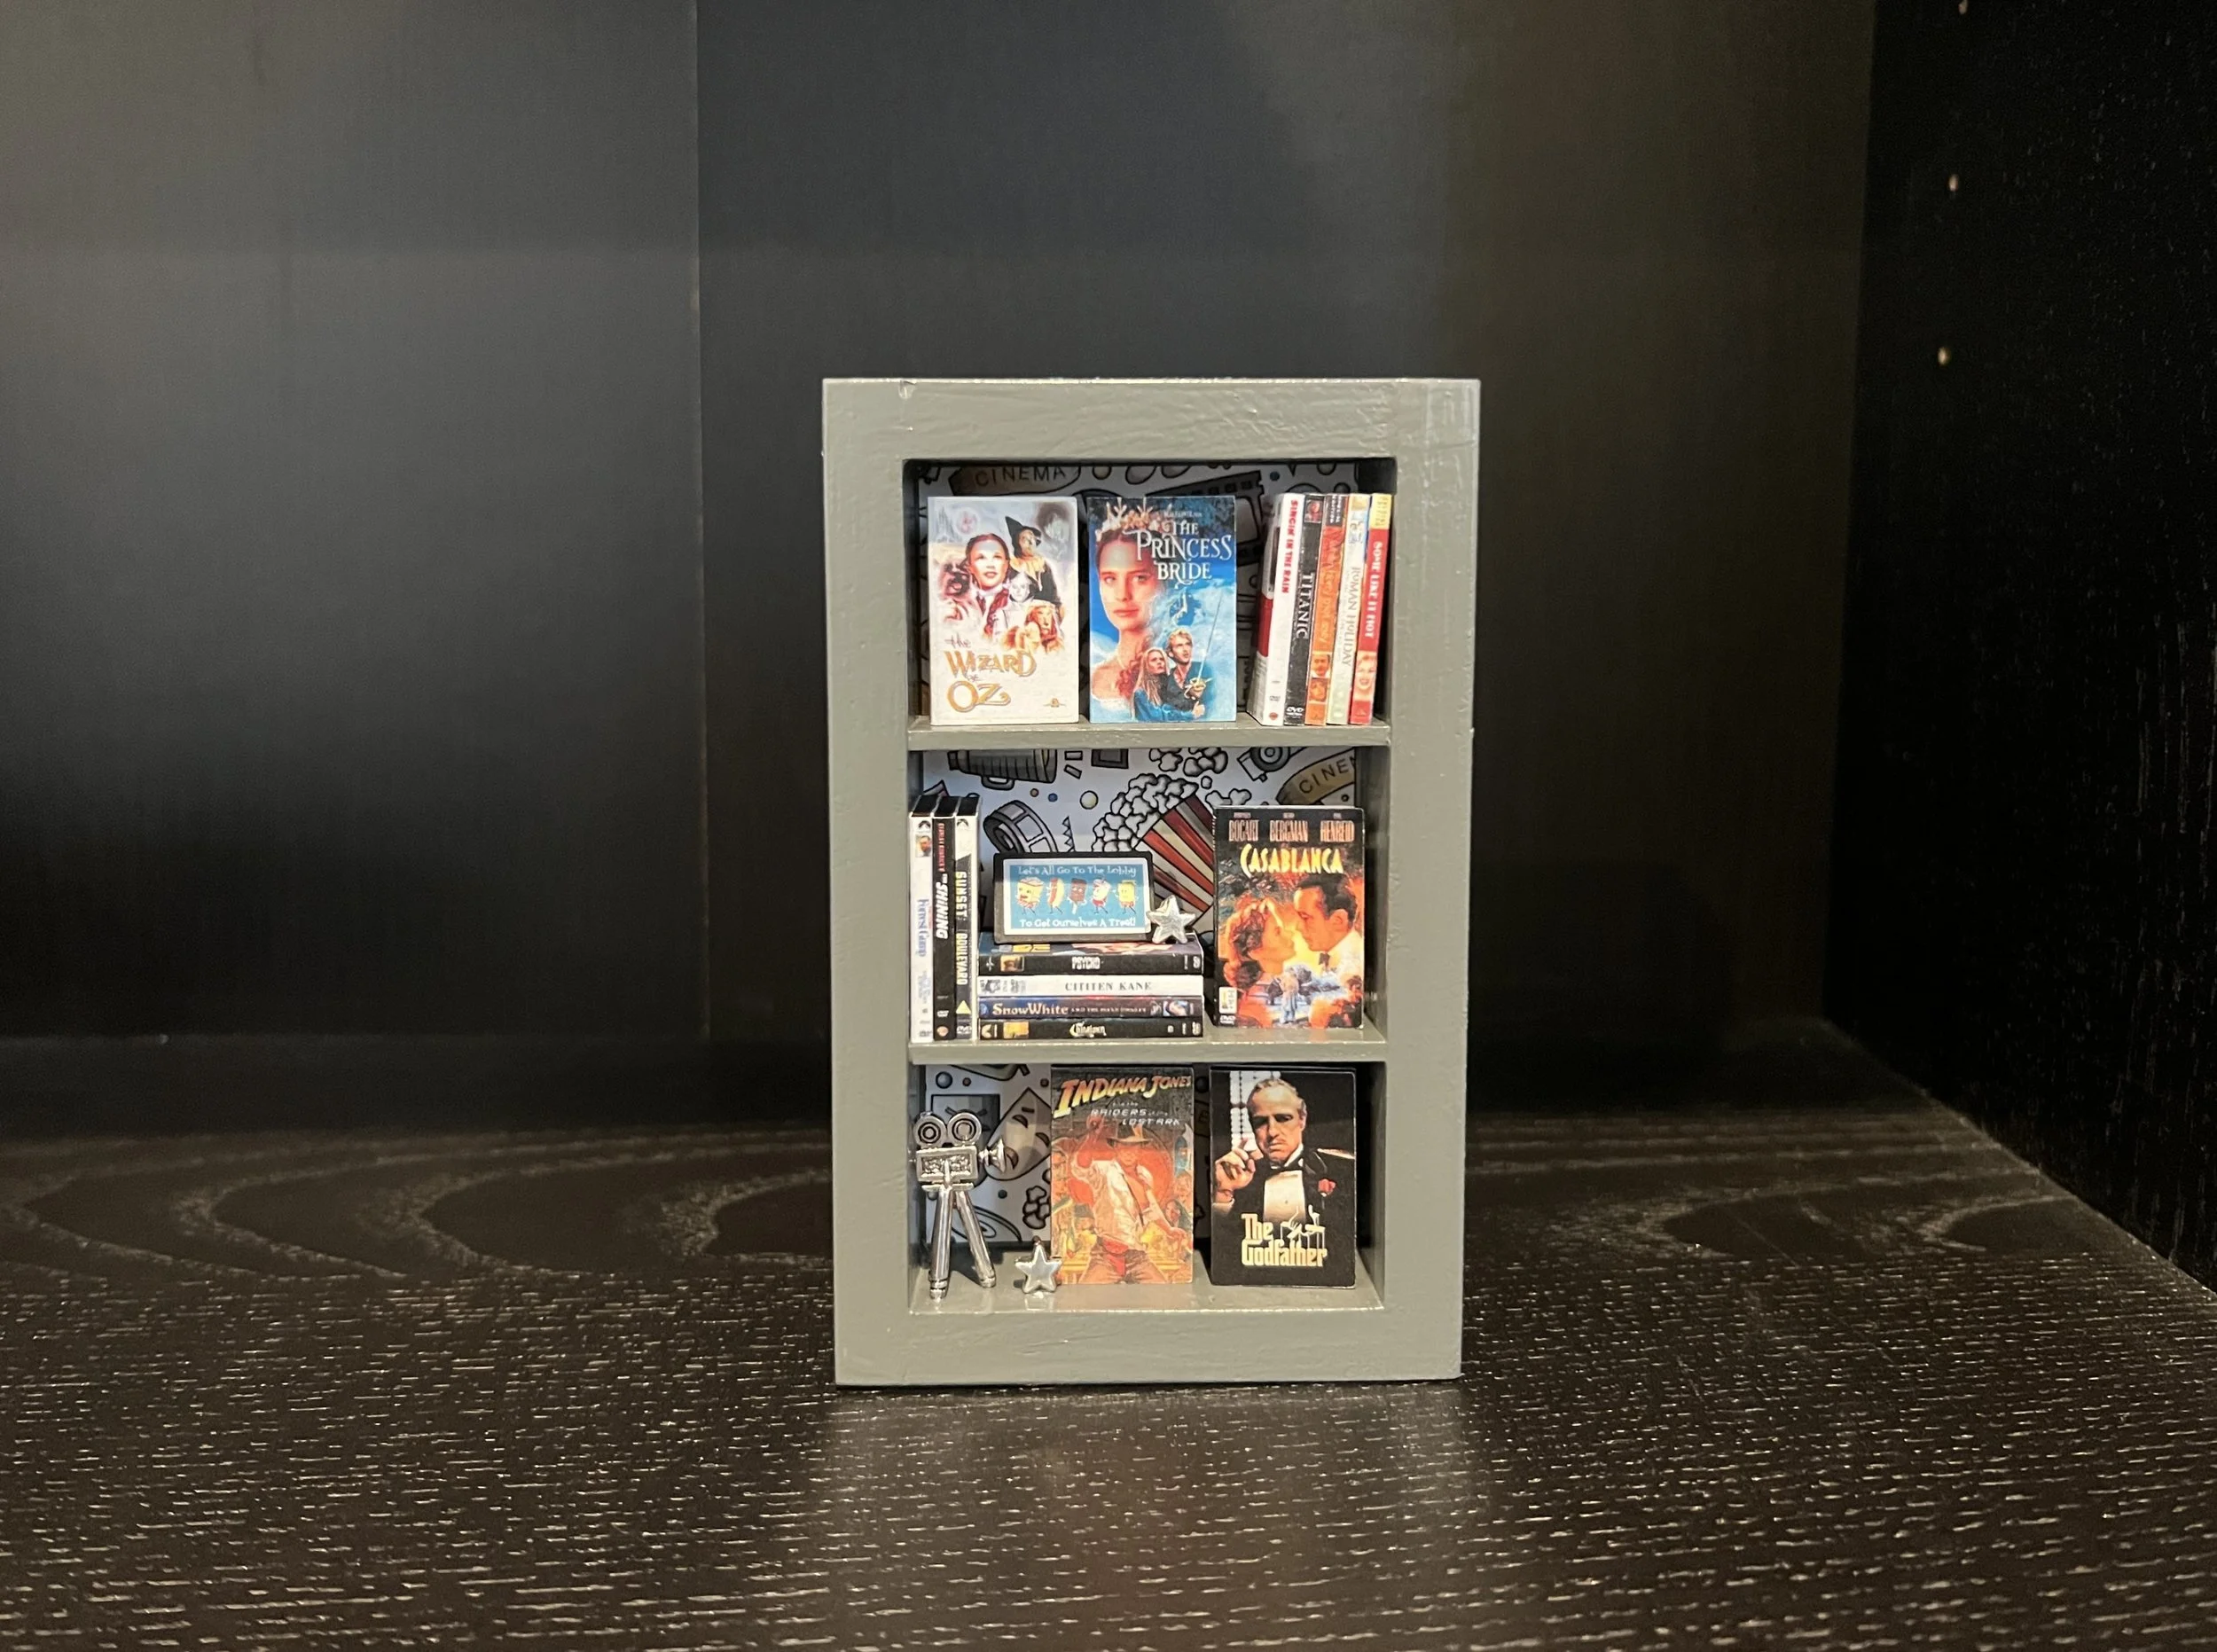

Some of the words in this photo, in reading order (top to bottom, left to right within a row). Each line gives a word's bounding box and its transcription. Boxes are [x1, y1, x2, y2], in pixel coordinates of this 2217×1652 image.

[975, 466, 1066, 486] CINEMA
[1163, 520, 1199, 536] THE
[1122, 529, 1233, 561] PRINCESS
[1285, 536, 1295, 549] IN
[1371, 541, 1383, 569] SOME
[1283, 551, 1294, 568] THE
[1154, 561, 1212, 587] BRIDE
[1281, 570, 1292, 593] RAIN
[1369, 574, 1381, 599] LIKE
[1297, 573, 1314, 638] TITANIC
[1365, 615, 1375, 638] HOT
[944, 649, 1037, 677] WIZARD
[1228, 819, 1259, 842] BOGART
[1269, 820, 1308, 842] BERGMAN
[1018, 865, 1039, 875] Let's
[1041, 865, 1054, 875] All
[1057, 865, 1070, 874] Go
[1073, 865, 1085, 874] To
[1087, 865, 1104, 874] The
[1107, 865, 1136, 877] Lobby
[1240, 843, 1344, 878] CASABLANCA
[955, 872, 967, 917] SUNSET
[1020, 918, 1033, 928] To
[1035, 918, 1050, 928] Get
[1052, 917, 1098, 928] Ourselves
[1099, 919, 1107, 928] A
[956, 933, 968, 985] BOULEVARD
[1071, 957, 1101, 970] PSYCHO
[1119, 982, 1152, 991] KANE
[1053, 1077, 1147, 1119] INDIANA
[1143, 1076, 1192, 1098] JONES
[1242, 1213, 1273, 1240] The
[1242, 1239, 1328, 1267] Godfather
